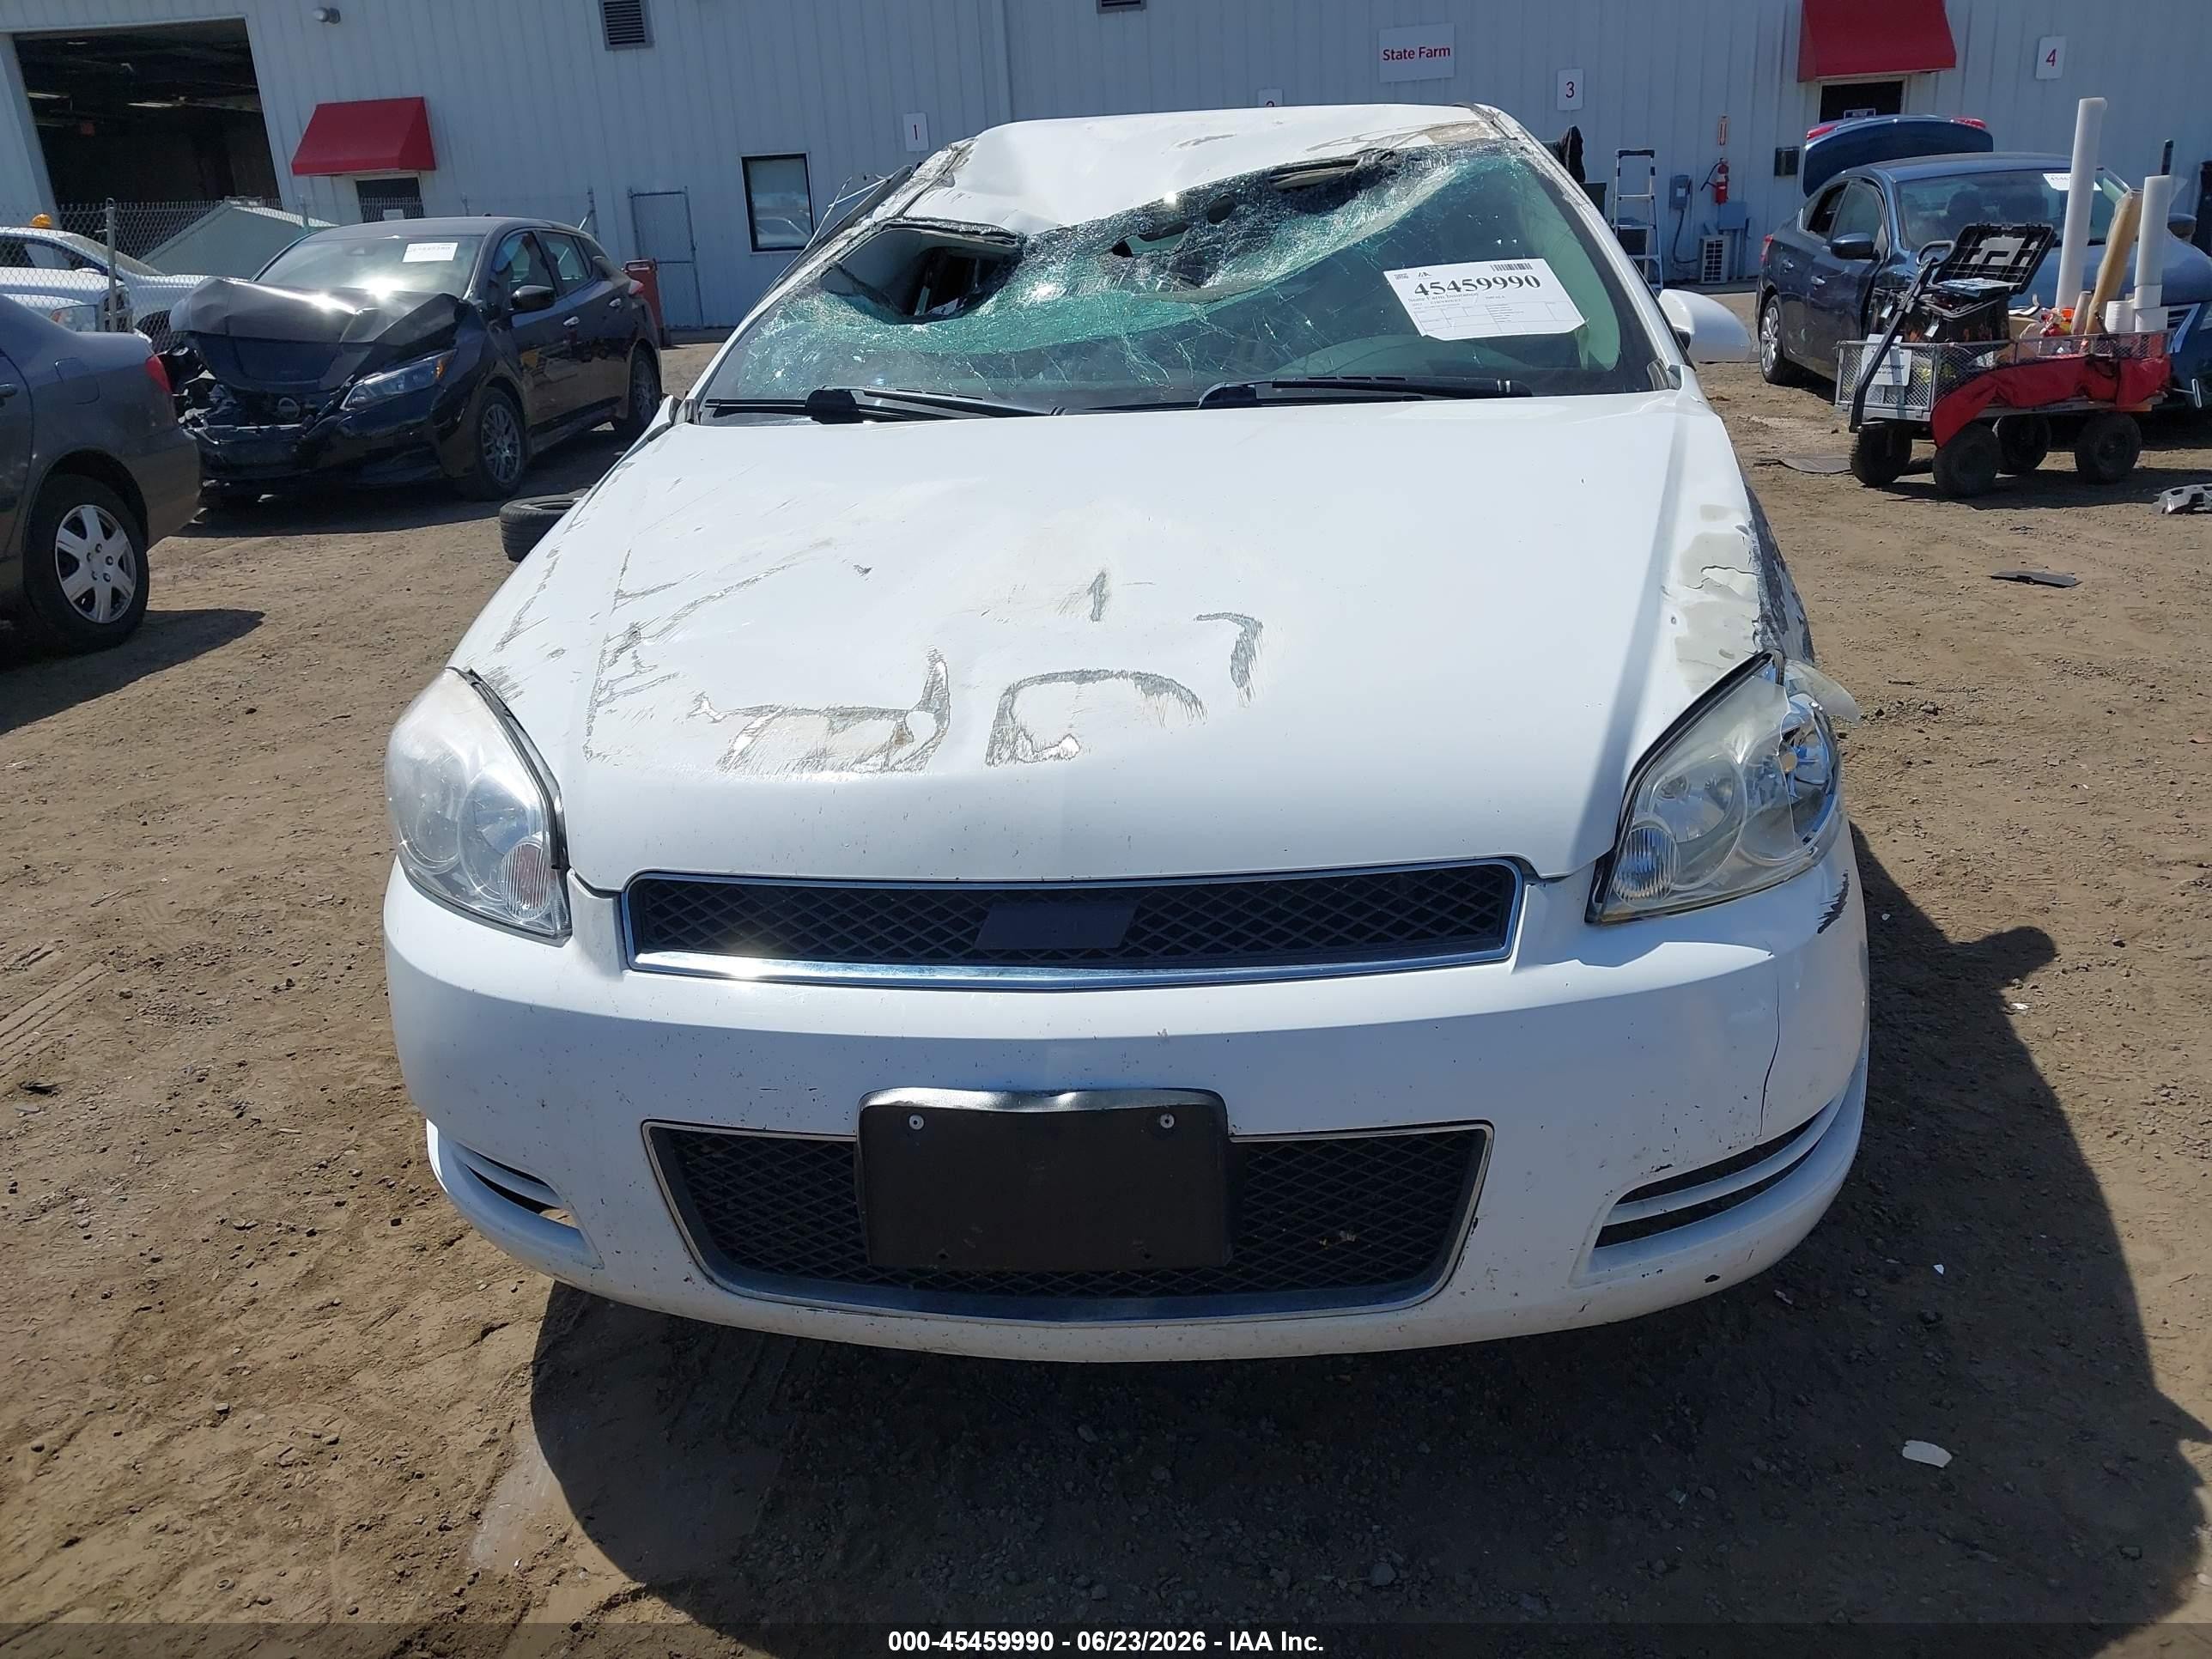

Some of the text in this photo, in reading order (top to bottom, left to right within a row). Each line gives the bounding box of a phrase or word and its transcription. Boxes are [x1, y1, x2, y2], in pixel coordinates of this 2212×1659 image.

[1382, 46, 1450, 61] State Farm
[2045, 48, 2057, 67] 4
[1565, 81, 1575, 99] 3
[1414, 274, 1541, 296] 45459990
